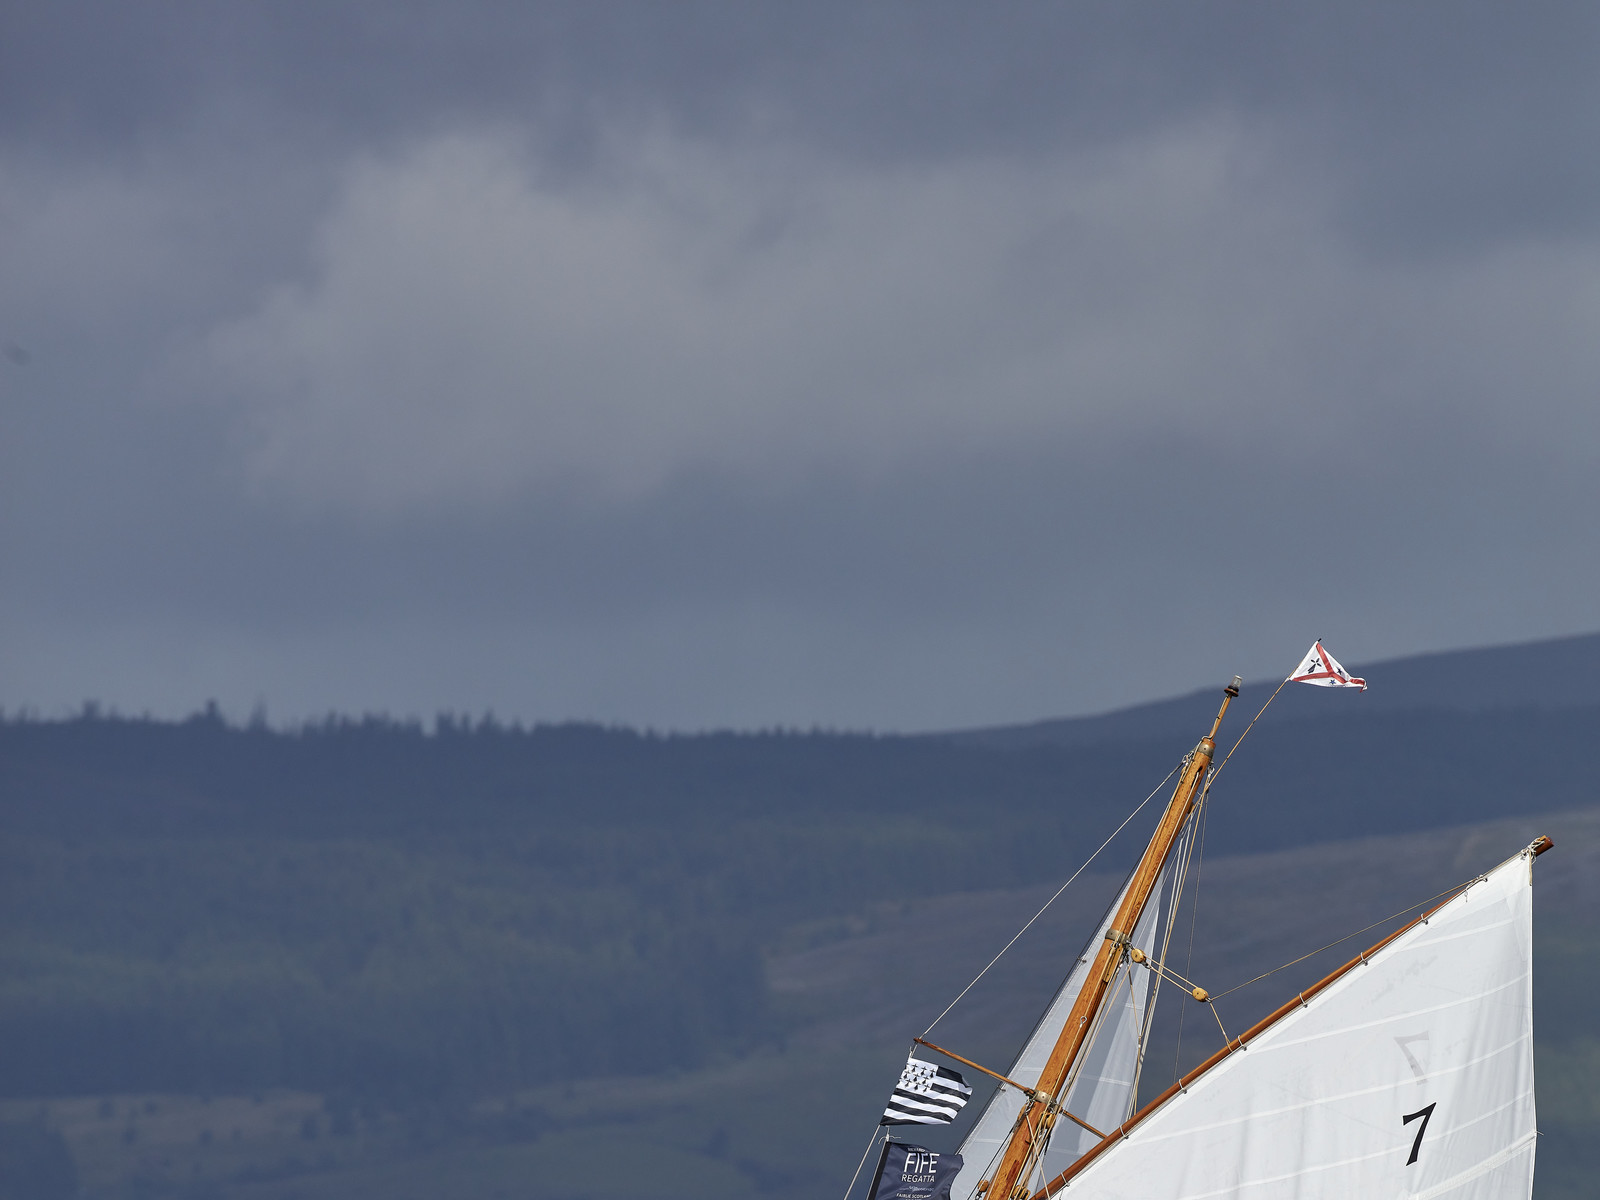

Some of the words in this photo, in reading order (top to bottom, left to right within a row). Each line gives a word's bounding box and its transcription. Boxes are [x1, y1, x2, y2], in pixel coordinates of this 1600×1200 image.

[1402, 1102, 1437, 1166] 7
[903, 1153, 940, 1173] FIFE
[901, 1174, 935, 1183] REGATTA
